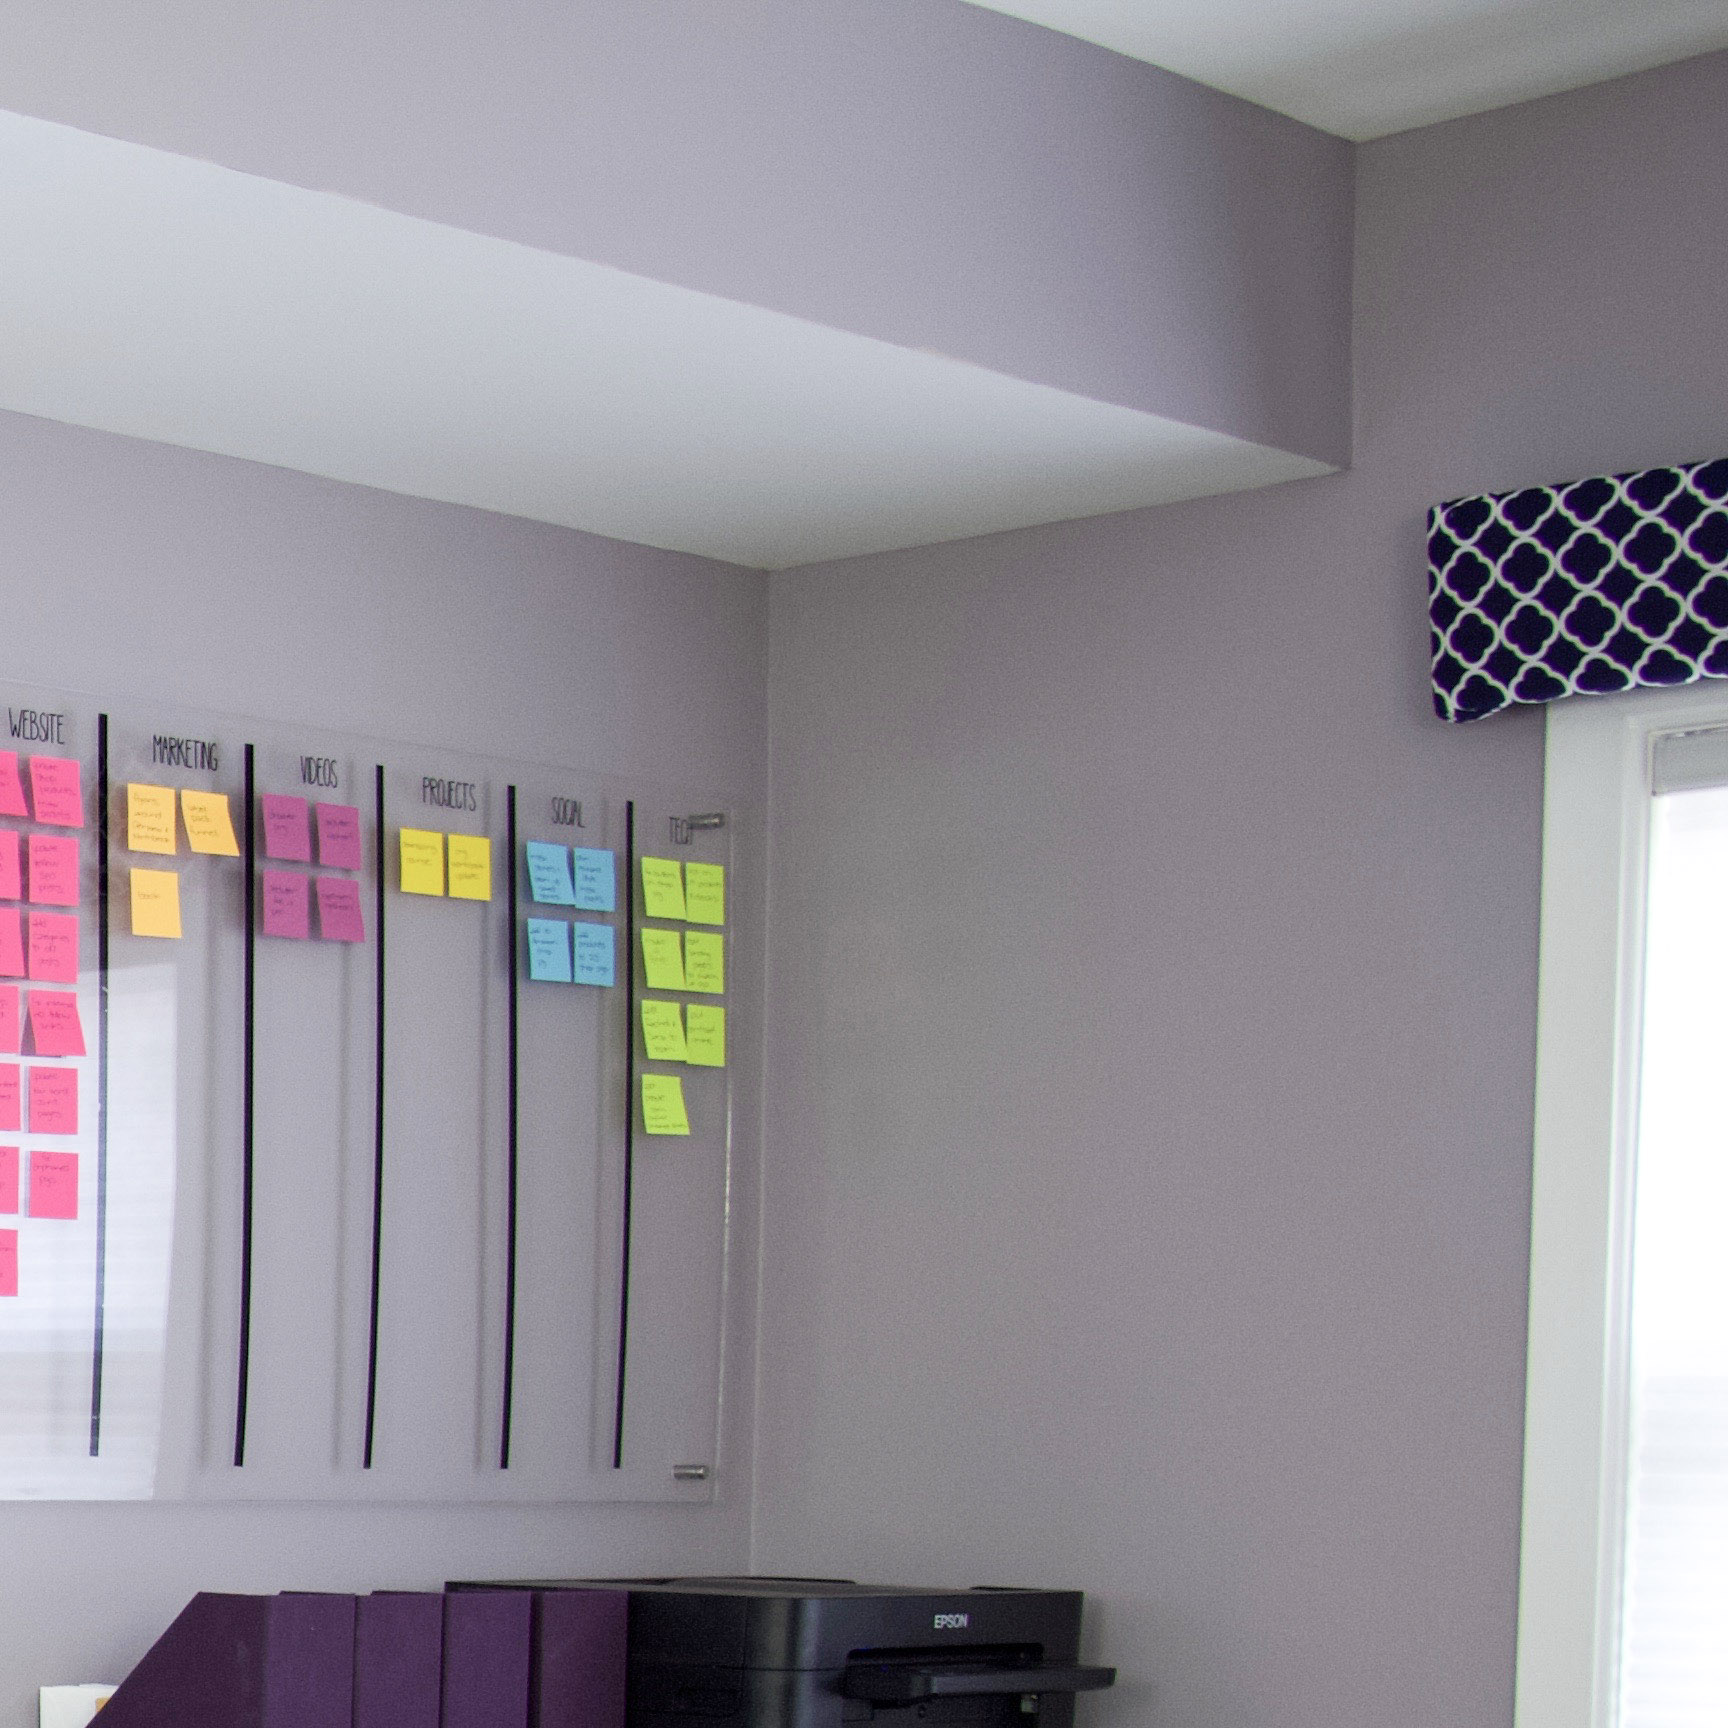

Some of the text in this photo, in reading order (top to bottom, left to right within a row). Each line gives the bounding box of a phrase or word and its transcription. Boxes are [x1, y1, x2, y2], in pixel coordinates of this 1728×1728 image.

[8, 707, 65, 745] WEBSITE
[152, 733, 219, 772] MARKETING
[300, 754, 338, 788] VIDEOS
[421, 776, 477, 812] PROJECTS
[551, 796, 586, 829] SOCIAL
[934, 1613, 968, 1629] EPSON
